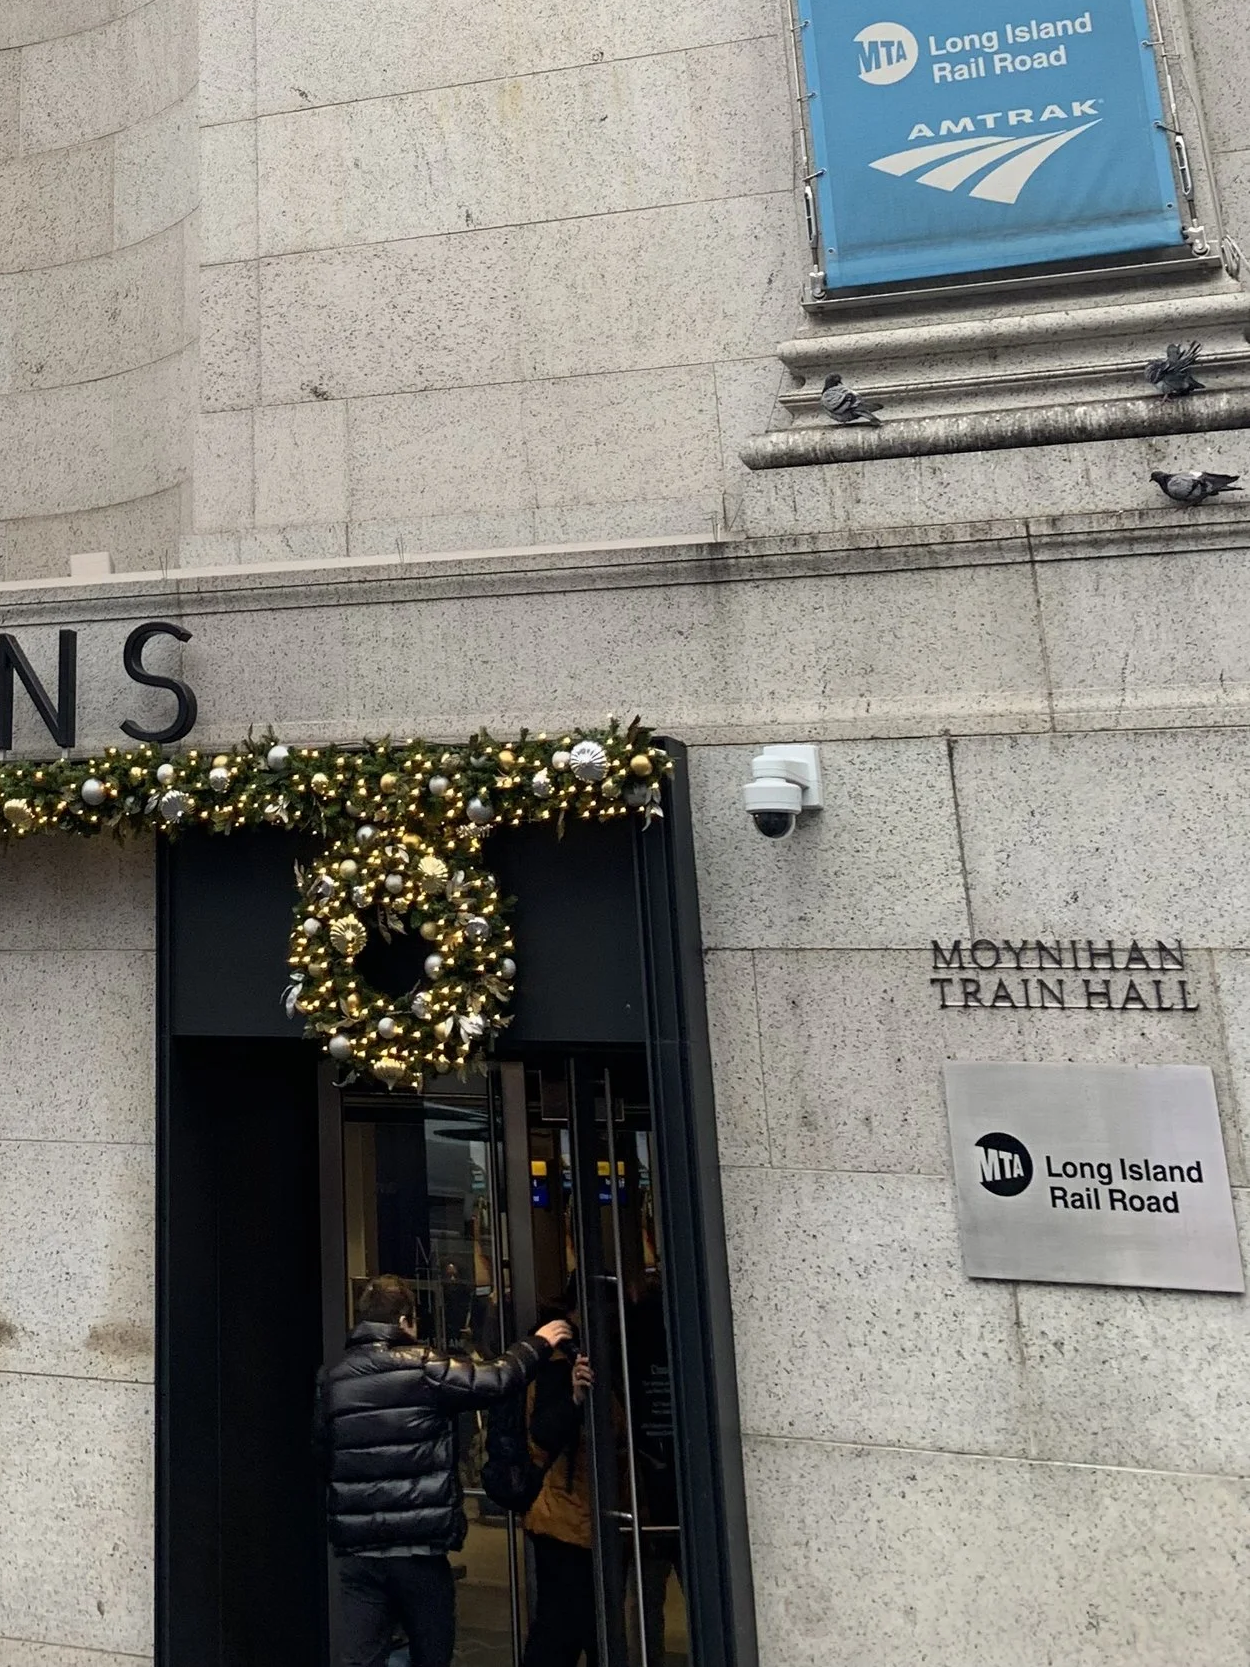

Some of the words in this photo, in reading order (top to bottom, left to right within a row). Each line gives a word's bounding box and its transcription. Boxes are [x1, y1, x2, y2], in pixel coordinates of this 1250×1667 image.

[929, 31, 998, 56] Long
[1005, 12, 1093, 45] Island
[854, 38, 910, 76] MTA
[932, 57, 986, 84] Rail
[994, 45, 1067, 75] Road
[907, 99, 1100, 140] AMTRAK
[931, 939, 1186, 971] MOYNIHAN
[930, 978, 1066, 1010] TRAIN
[1084, 979, 1200, 1011] HALL
[974, 1142, 1027, 1185] MTA
[1046, 1156, 1113, 1185] Long
[1120, 1158, 1204, 1183] Island
[1050, 1186, 1101, 1210] Rail
[1109, 1189, 1180, 1213] Road
